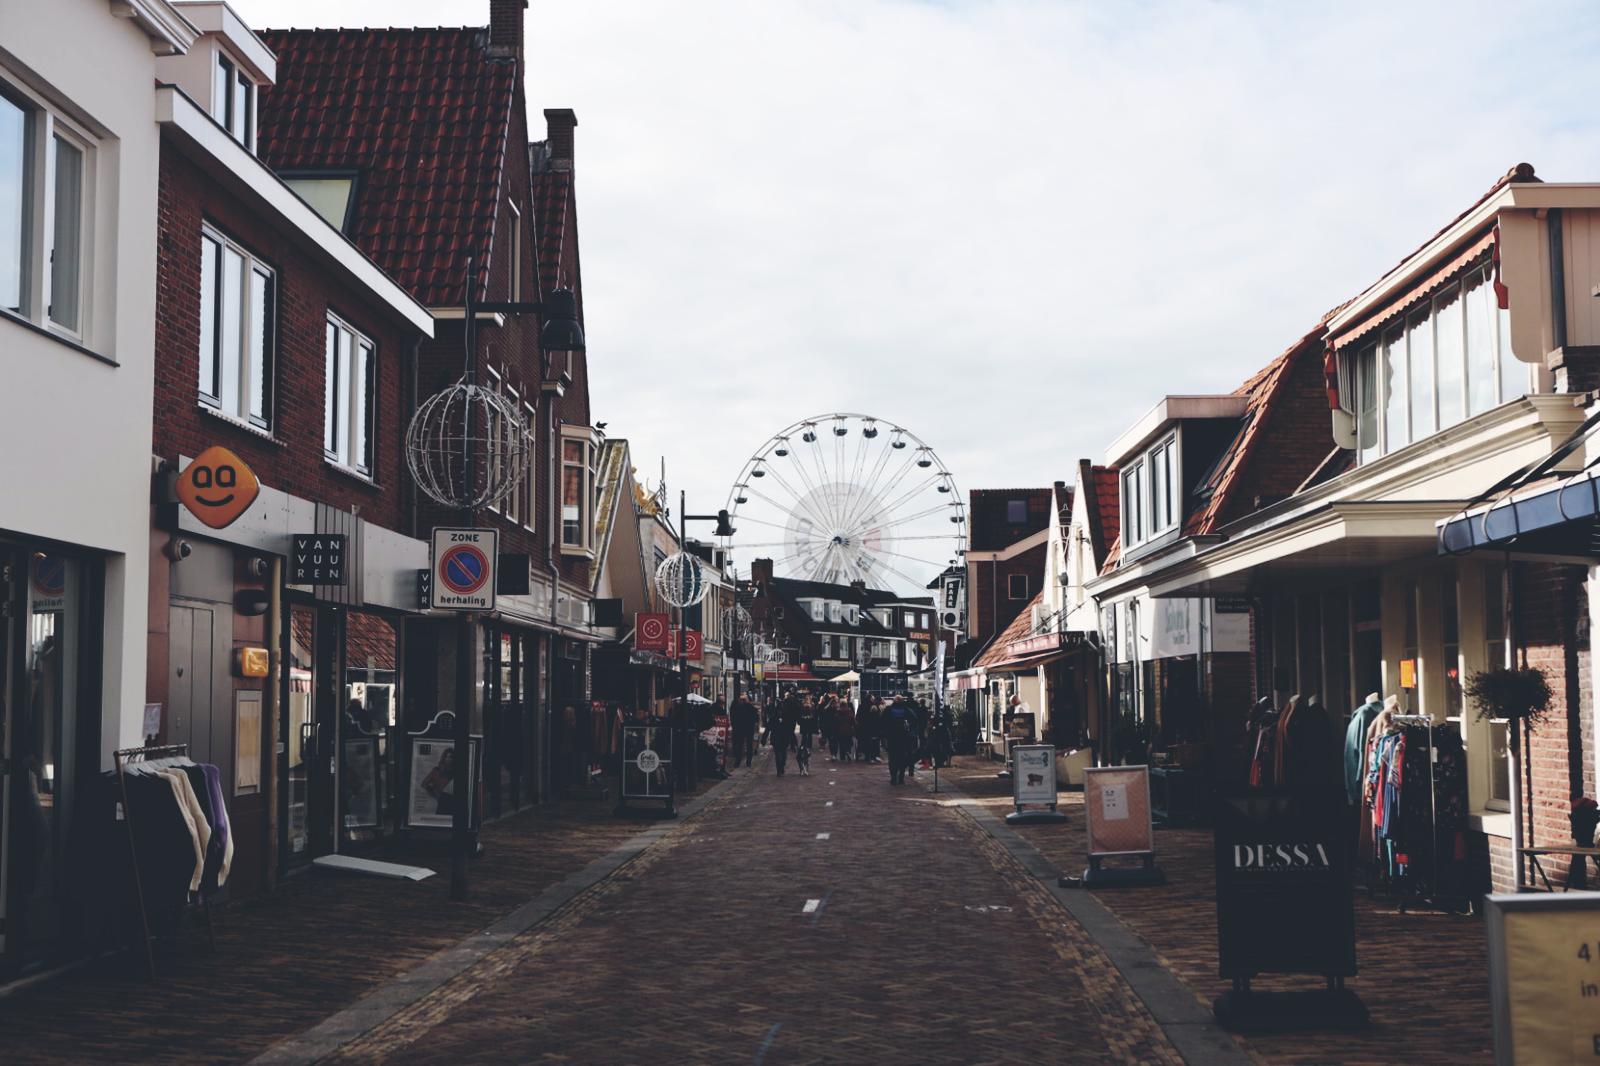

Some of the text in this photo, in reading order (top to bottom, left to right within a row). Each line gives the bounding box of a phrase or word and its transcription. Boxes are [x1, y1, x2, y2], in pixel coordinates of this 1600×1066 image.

[451, 533, 480, 542] ZONE
[298, 540, 340, 550] VAN
[297, 554, 339, 565] VUU
[297, 568, 339, 579] REN
[440, 595, 486, 606] herhaling
[1233, 843, 1330, 868] DESSA
[1577, 943, 1591, 962] 4
[1581, 981, 1598, 997] in
